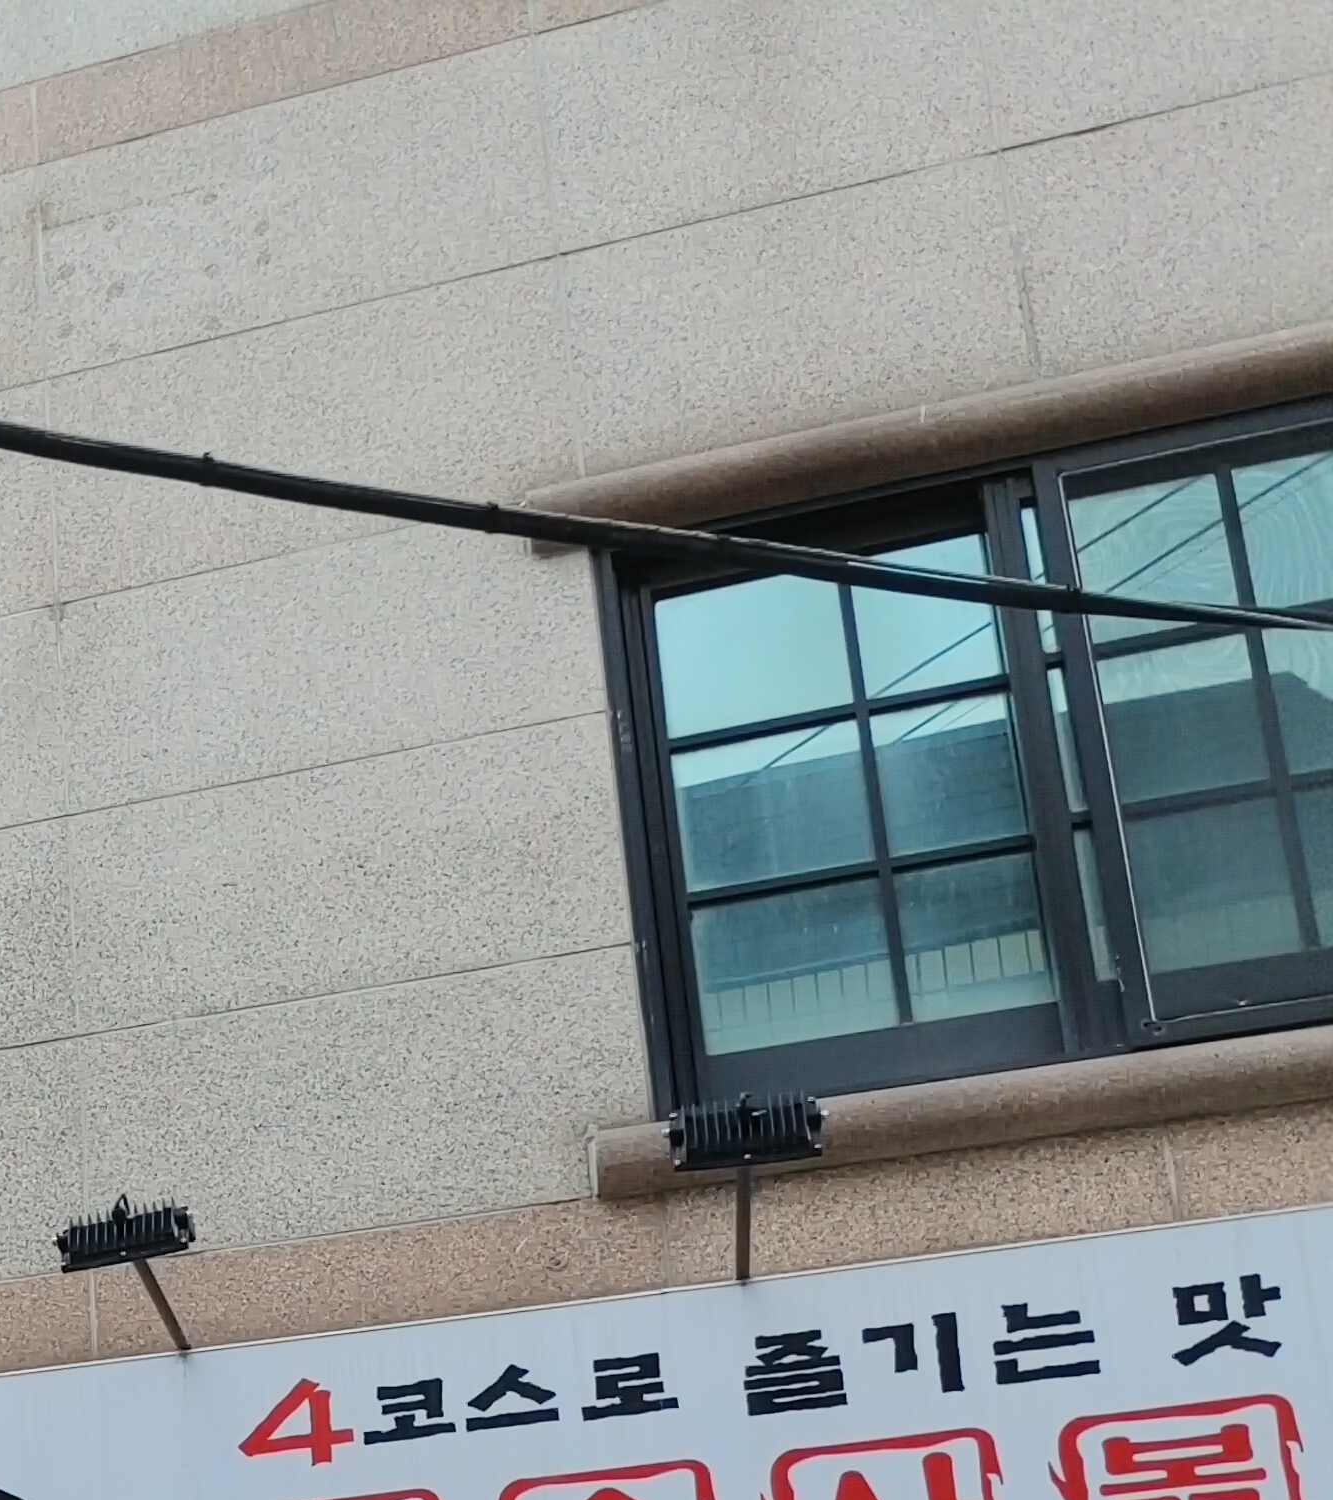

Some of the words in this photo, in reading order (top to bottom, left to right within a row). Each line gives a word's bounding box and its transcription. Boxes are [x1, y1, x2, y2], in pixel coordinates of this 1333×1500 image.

[238, 1352, 680, 1467] 4코스로
[743, 1303, 1101, 1417] 즐기는
[1171, 1273, 1282, 1367] 맛
